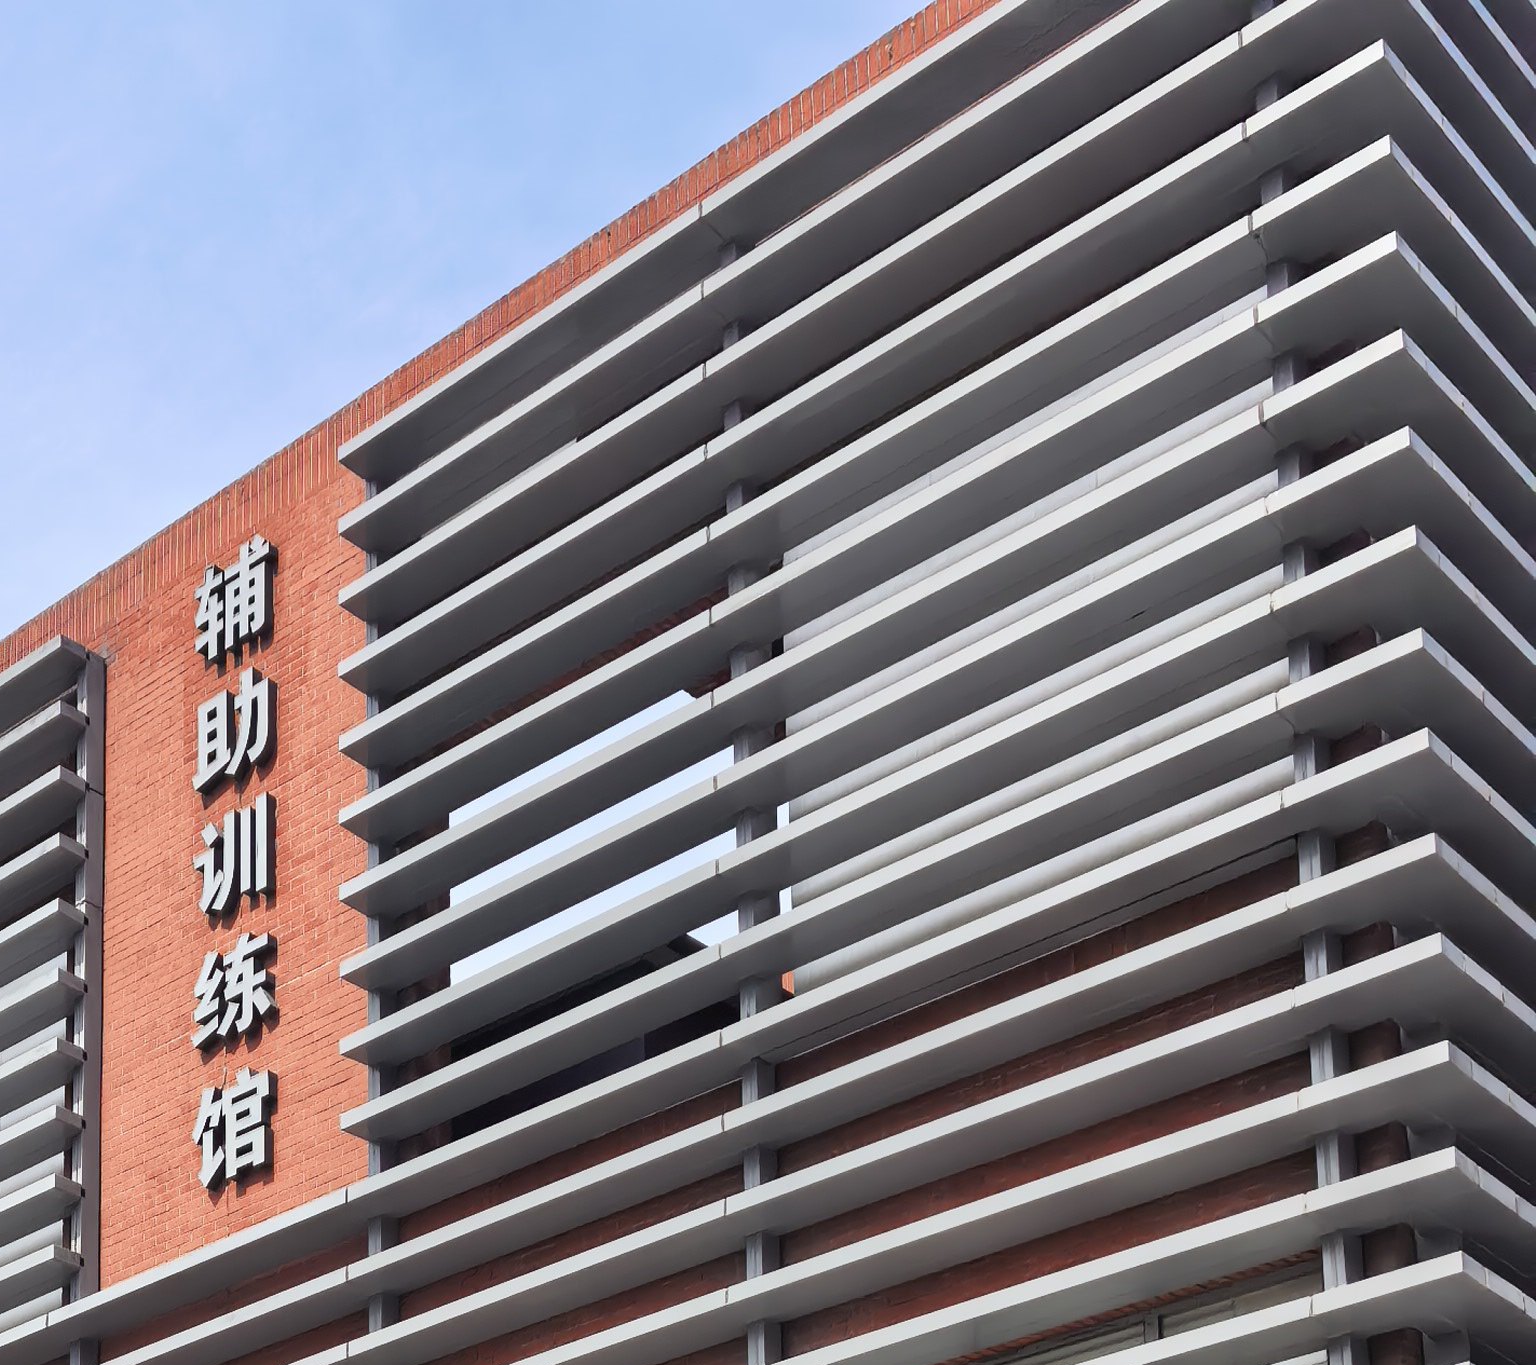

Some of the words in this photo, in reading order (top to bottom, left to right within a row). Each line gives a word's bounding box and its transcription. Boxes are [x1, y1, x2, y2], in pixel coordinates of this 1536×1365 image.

[192, 533, 274, 1191] 辅助训练馆
